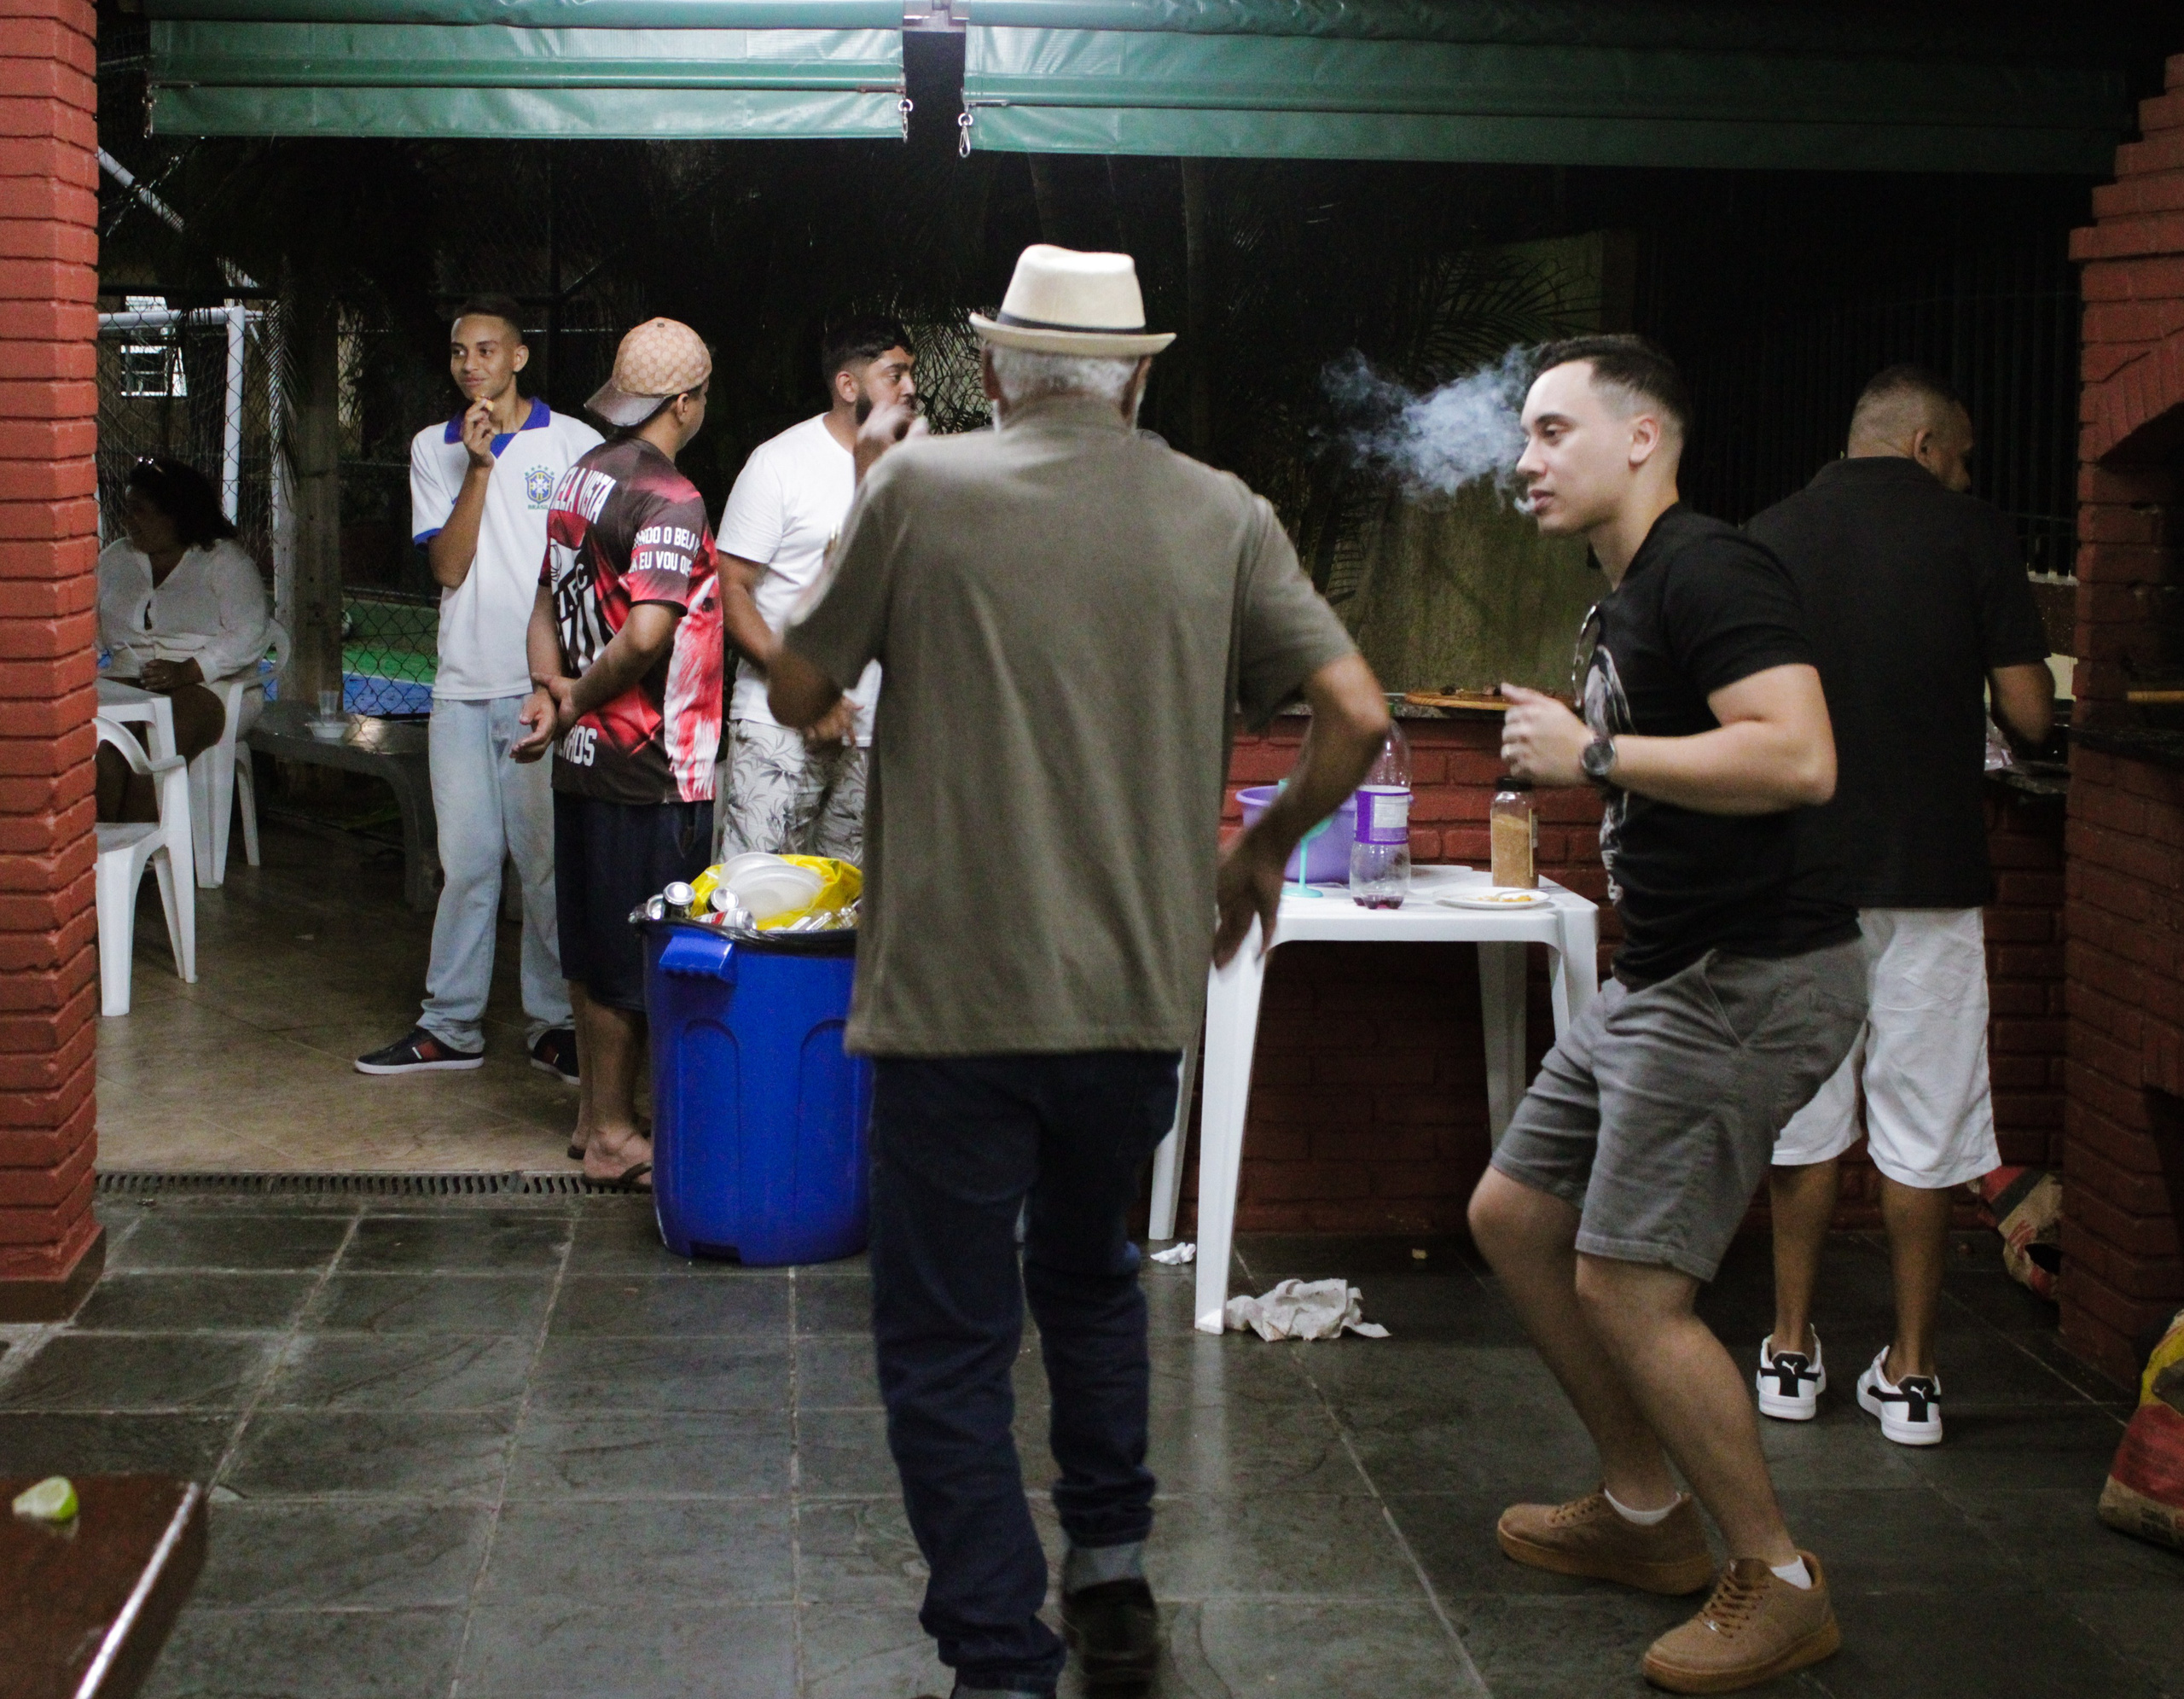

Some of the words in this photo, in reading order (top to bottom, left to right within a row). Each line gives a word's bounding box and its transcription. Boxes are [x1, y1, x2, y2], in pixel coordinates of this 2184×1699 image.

[551, 466, 586, 514] ELA
[663, 526, 672, 544] O
[639, 550, 653, 571] EU
[655, 550, 679, 572] VOU
